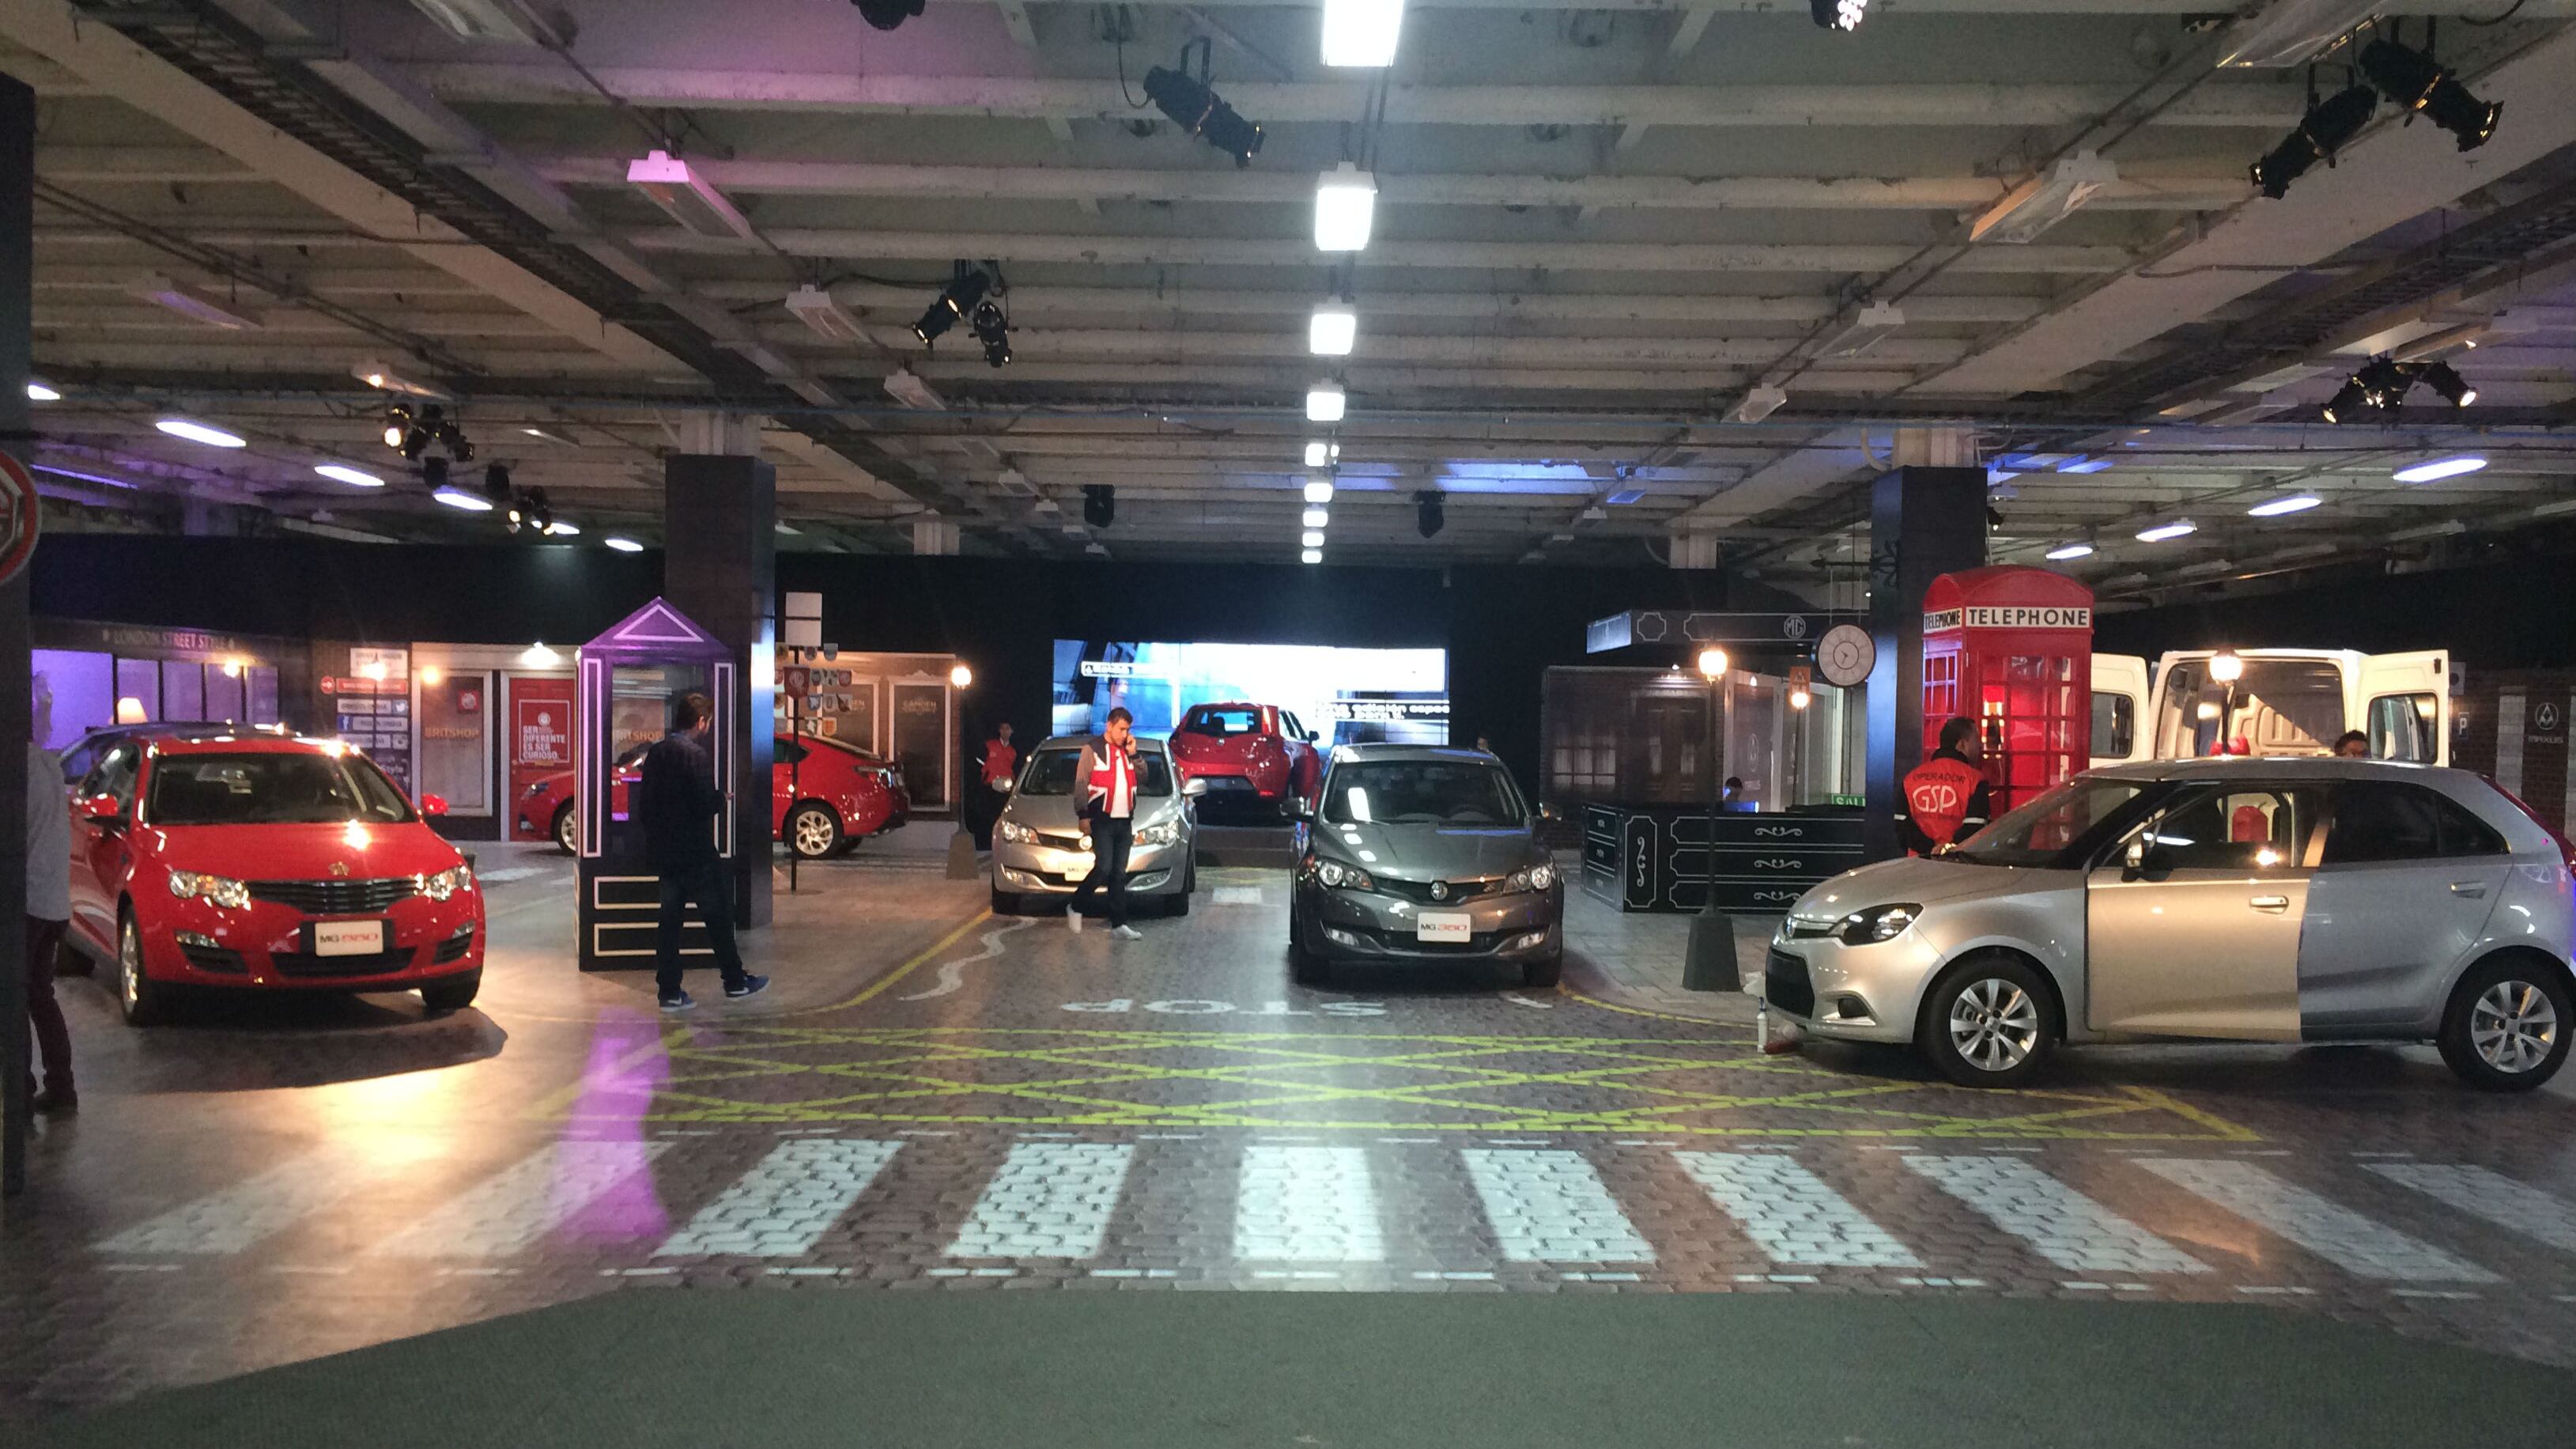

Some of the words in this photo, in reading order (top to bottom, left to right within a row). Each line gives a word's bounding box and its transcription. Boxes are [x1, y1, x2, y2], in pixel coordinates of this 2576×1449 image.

[1924, 610, 1961, 630] TELEPHONE
[1969, 609, 2087, 625] TELEPHONE
[1785, 615, 1806, 639] MG
[162, 632, 196, 649] STREET
[424, 727, 480, 740] BRITSHOP
[523, 725, 538, 735] SER
[2459, 717, 2468, 735] P
[523, 734, 566, 743] DIFERENTE
[1913, 785, 1957, 813] GSP
[1060, 999, 1387, 1016] STOP
